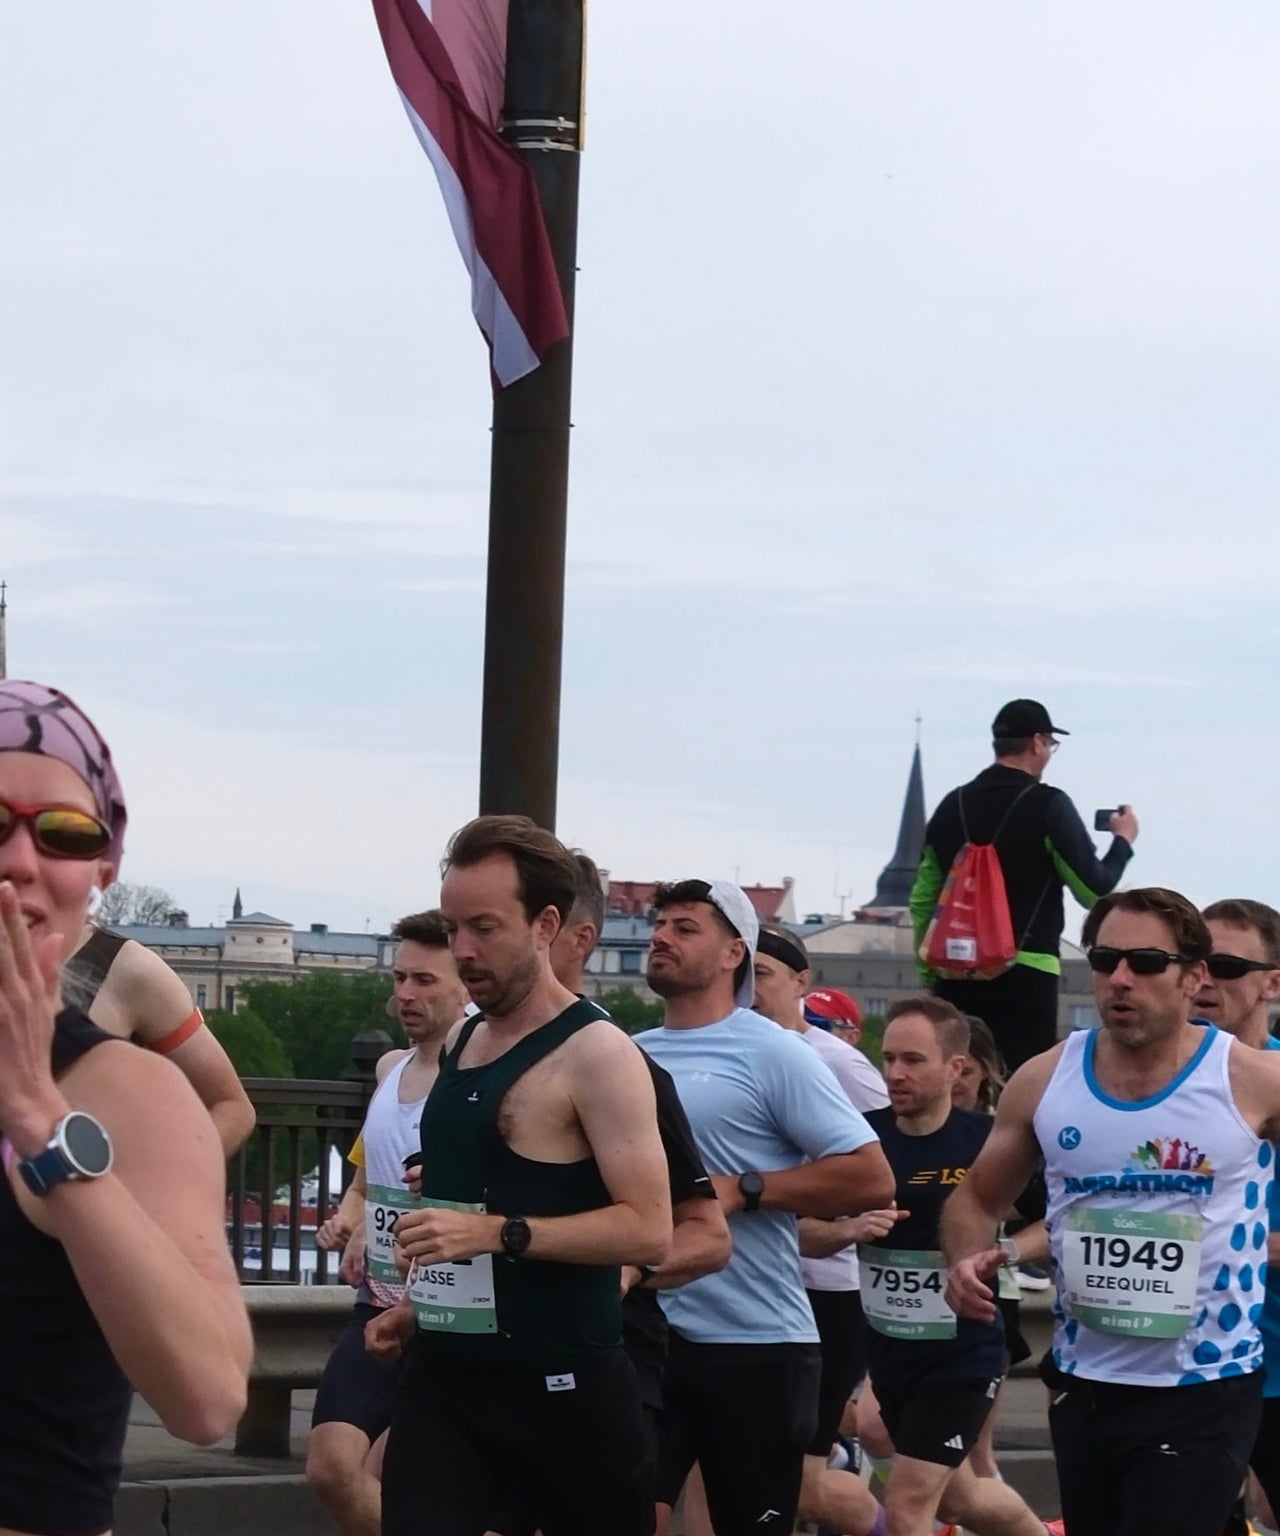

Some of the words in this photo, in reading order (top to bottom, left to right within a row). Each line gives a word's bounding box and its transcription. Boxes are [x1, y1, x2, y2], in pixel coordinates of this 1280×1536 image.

[940, 1168, 968, 1185] LS
[1064, 1174, 1216, 1195] MARATHON
[375, 1207, 410, 1233] 92
[1080, 1235, 1184, 1272] 11949
[419, 1269, 455, 1286] LASSE
[869, 1266, 942, 1294] 7954
[1086, 1274, 1174, 1294] EZEQUIEL
[886, 1296, 923, 1309] ROSS
